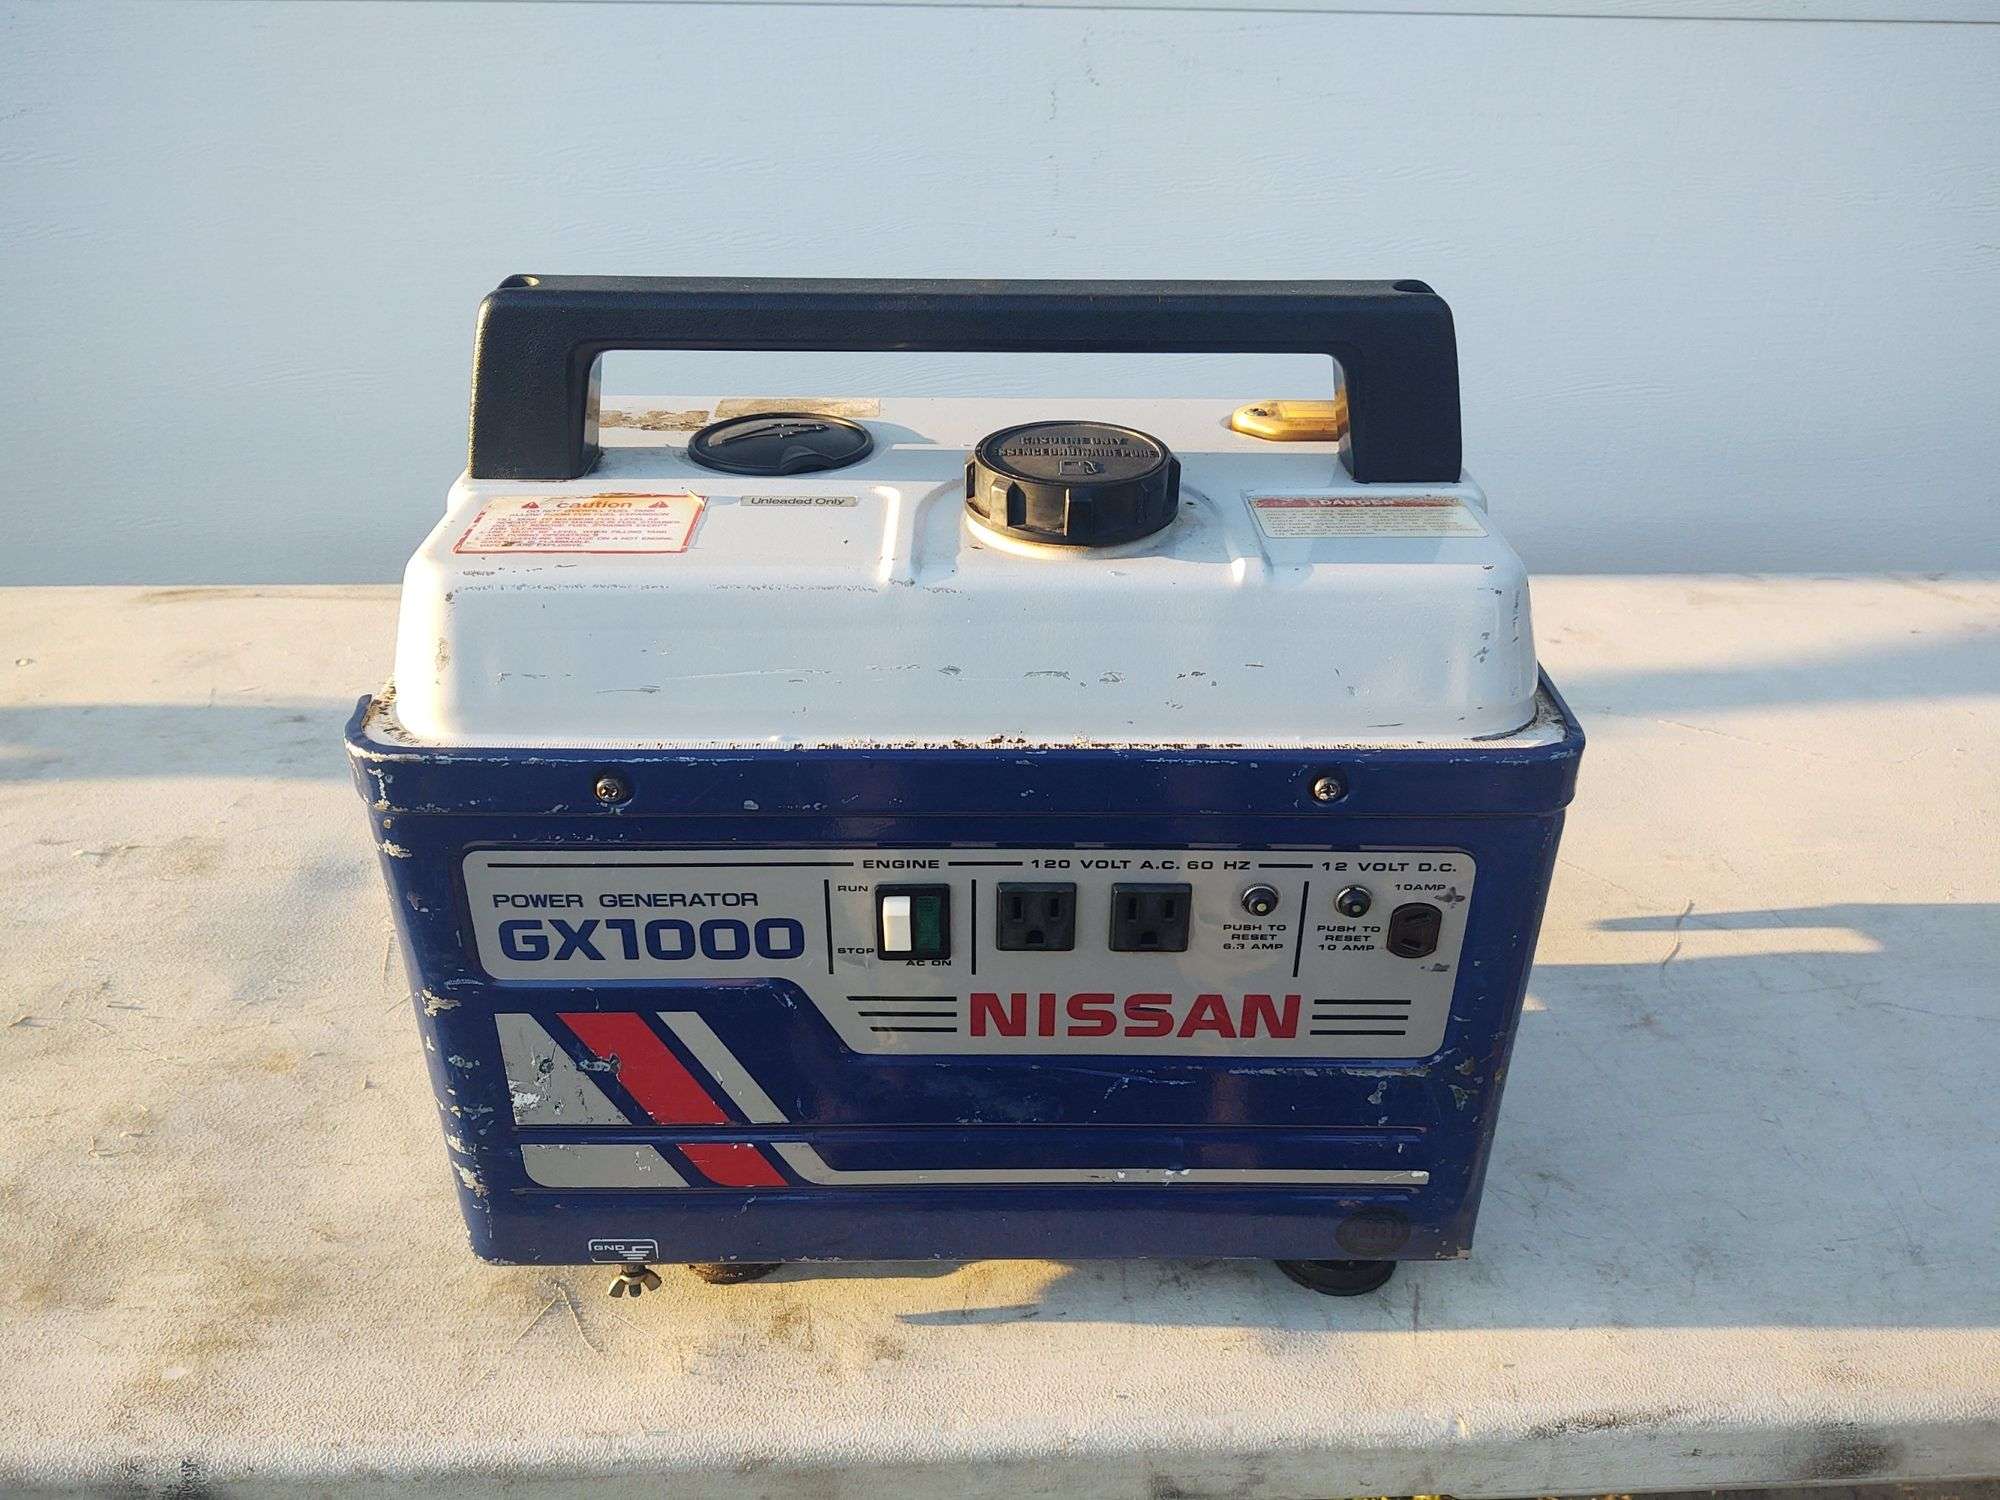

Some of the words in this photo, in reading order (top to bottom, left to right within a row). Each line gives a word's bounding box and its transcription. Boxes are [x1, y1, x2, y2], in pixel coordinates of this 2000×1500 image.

[556, 501, 633, 509] caution
[751, 497, 812, 505] Unleaded
[815, 497, 845, 506] Only
[863, 859, 940, 869] ENGINE
[1031, 859, 1071, 869] 120
[1080, 860, 1131, 870] VOLT
[1140, 860, 1180, 870] A.C.
[1187, 860, 1213, 870] 60
[1223, 861, 1251, 870] HZ
[1322, 862, 1347, 872] 12
[1358, 862, 1410, 872] VOLT
[1418, 862, 1457, 872] D.C.
[493, 893, 584, 908] POWER
[599, 892, 759, 908] GENERATOR
[1268, 924, 1287, 932] TO
[1362, 925, 1381, 933] TO
[498, 917, 806, 961] GX1000
[1231, 933, 1277, 941] RESET
[1325, 934, 1371, 942] RESET
[1343, 944, 1375, 952] AMP
[970, 992, 1301, 1040] NISSAN
